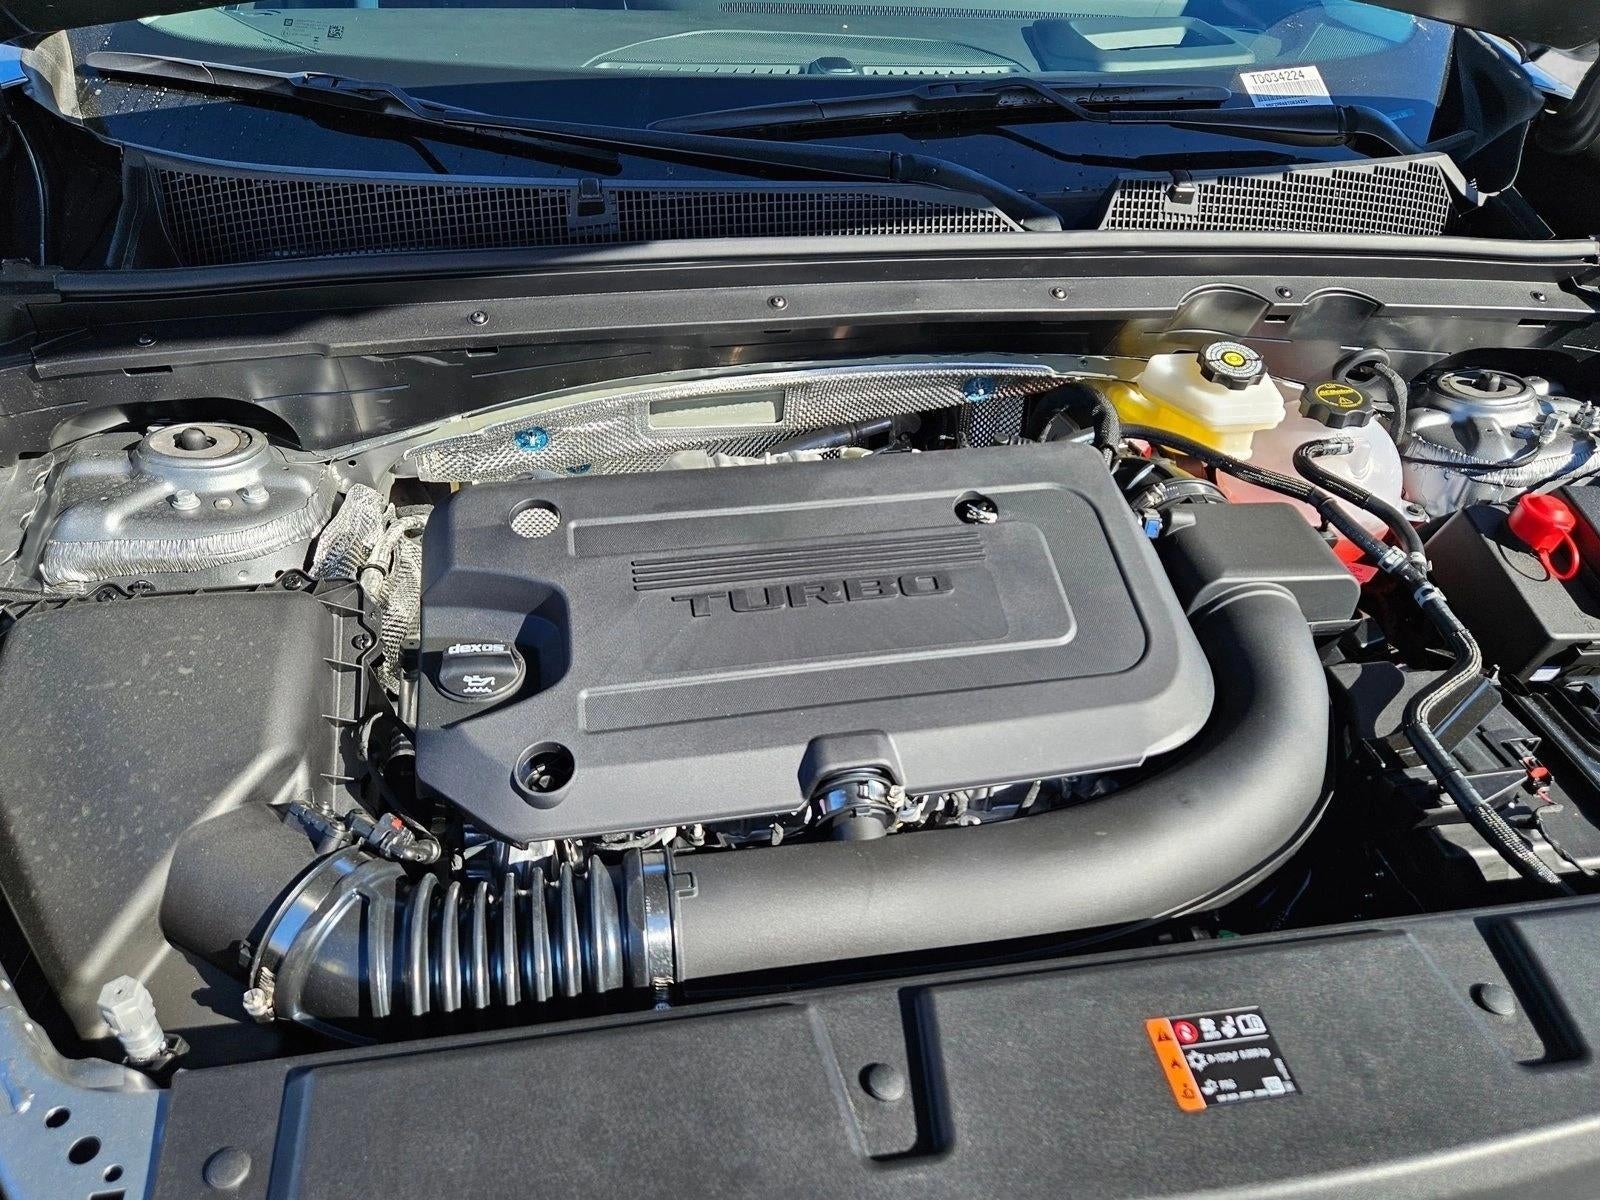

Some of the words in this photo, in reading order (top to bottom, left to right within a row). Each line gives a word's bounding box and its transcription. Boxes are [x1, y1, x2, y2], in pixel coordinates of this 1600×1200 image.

[1250, 70, 1305, 85] TD034224
[671, 571, 956, 618] TURBO
[448, 643, 505, 655] dexos
